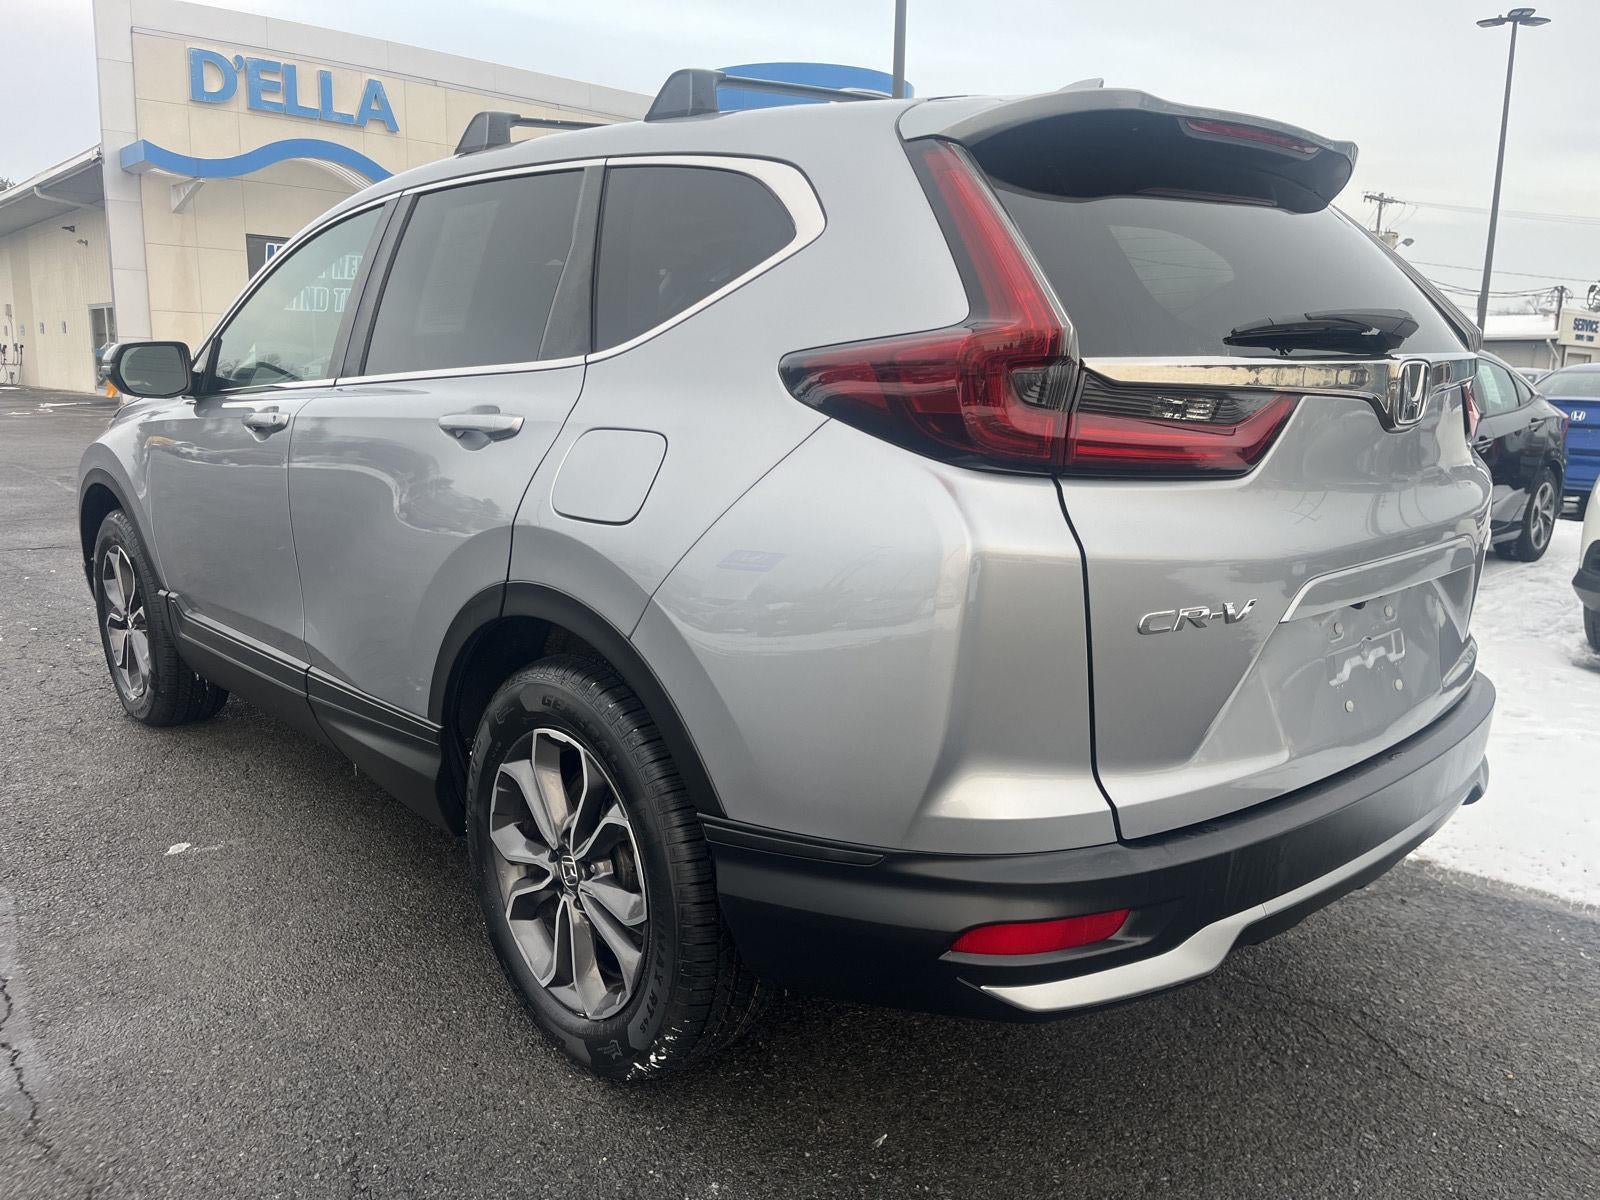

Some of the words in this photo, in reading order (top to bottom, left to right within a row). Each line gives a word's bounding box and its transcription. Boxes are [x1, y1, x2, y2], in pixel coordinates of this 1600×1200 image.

[187, 46, 400, 133] D'ELLA
[1573, 317, 1600, 334] SERVICE
[1137, 598, 1258, 636] CR-V
